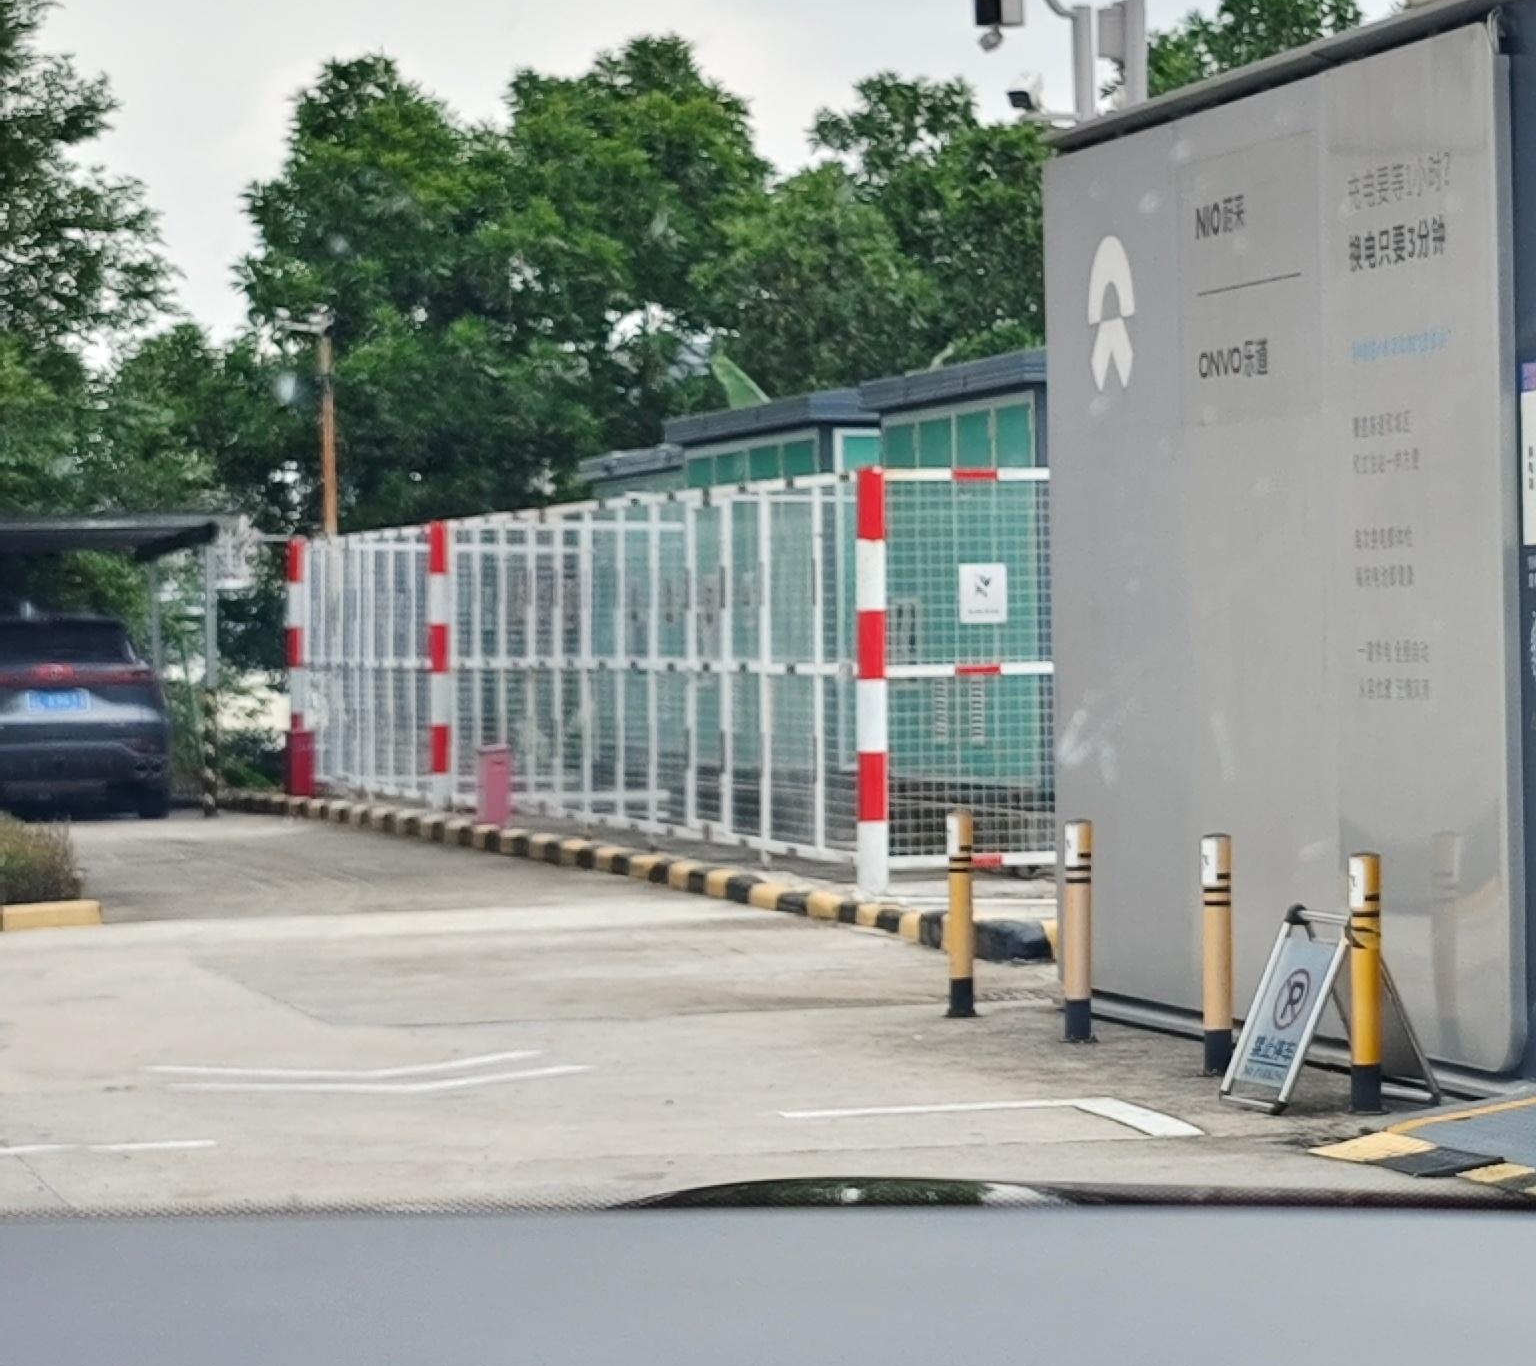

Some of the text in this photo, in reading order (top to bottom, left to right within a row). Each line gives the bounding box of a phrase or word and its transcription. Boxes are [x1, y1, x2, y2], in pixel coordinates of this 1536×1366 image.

[1349, 215, 1446, 272] 换电只要3分钟
